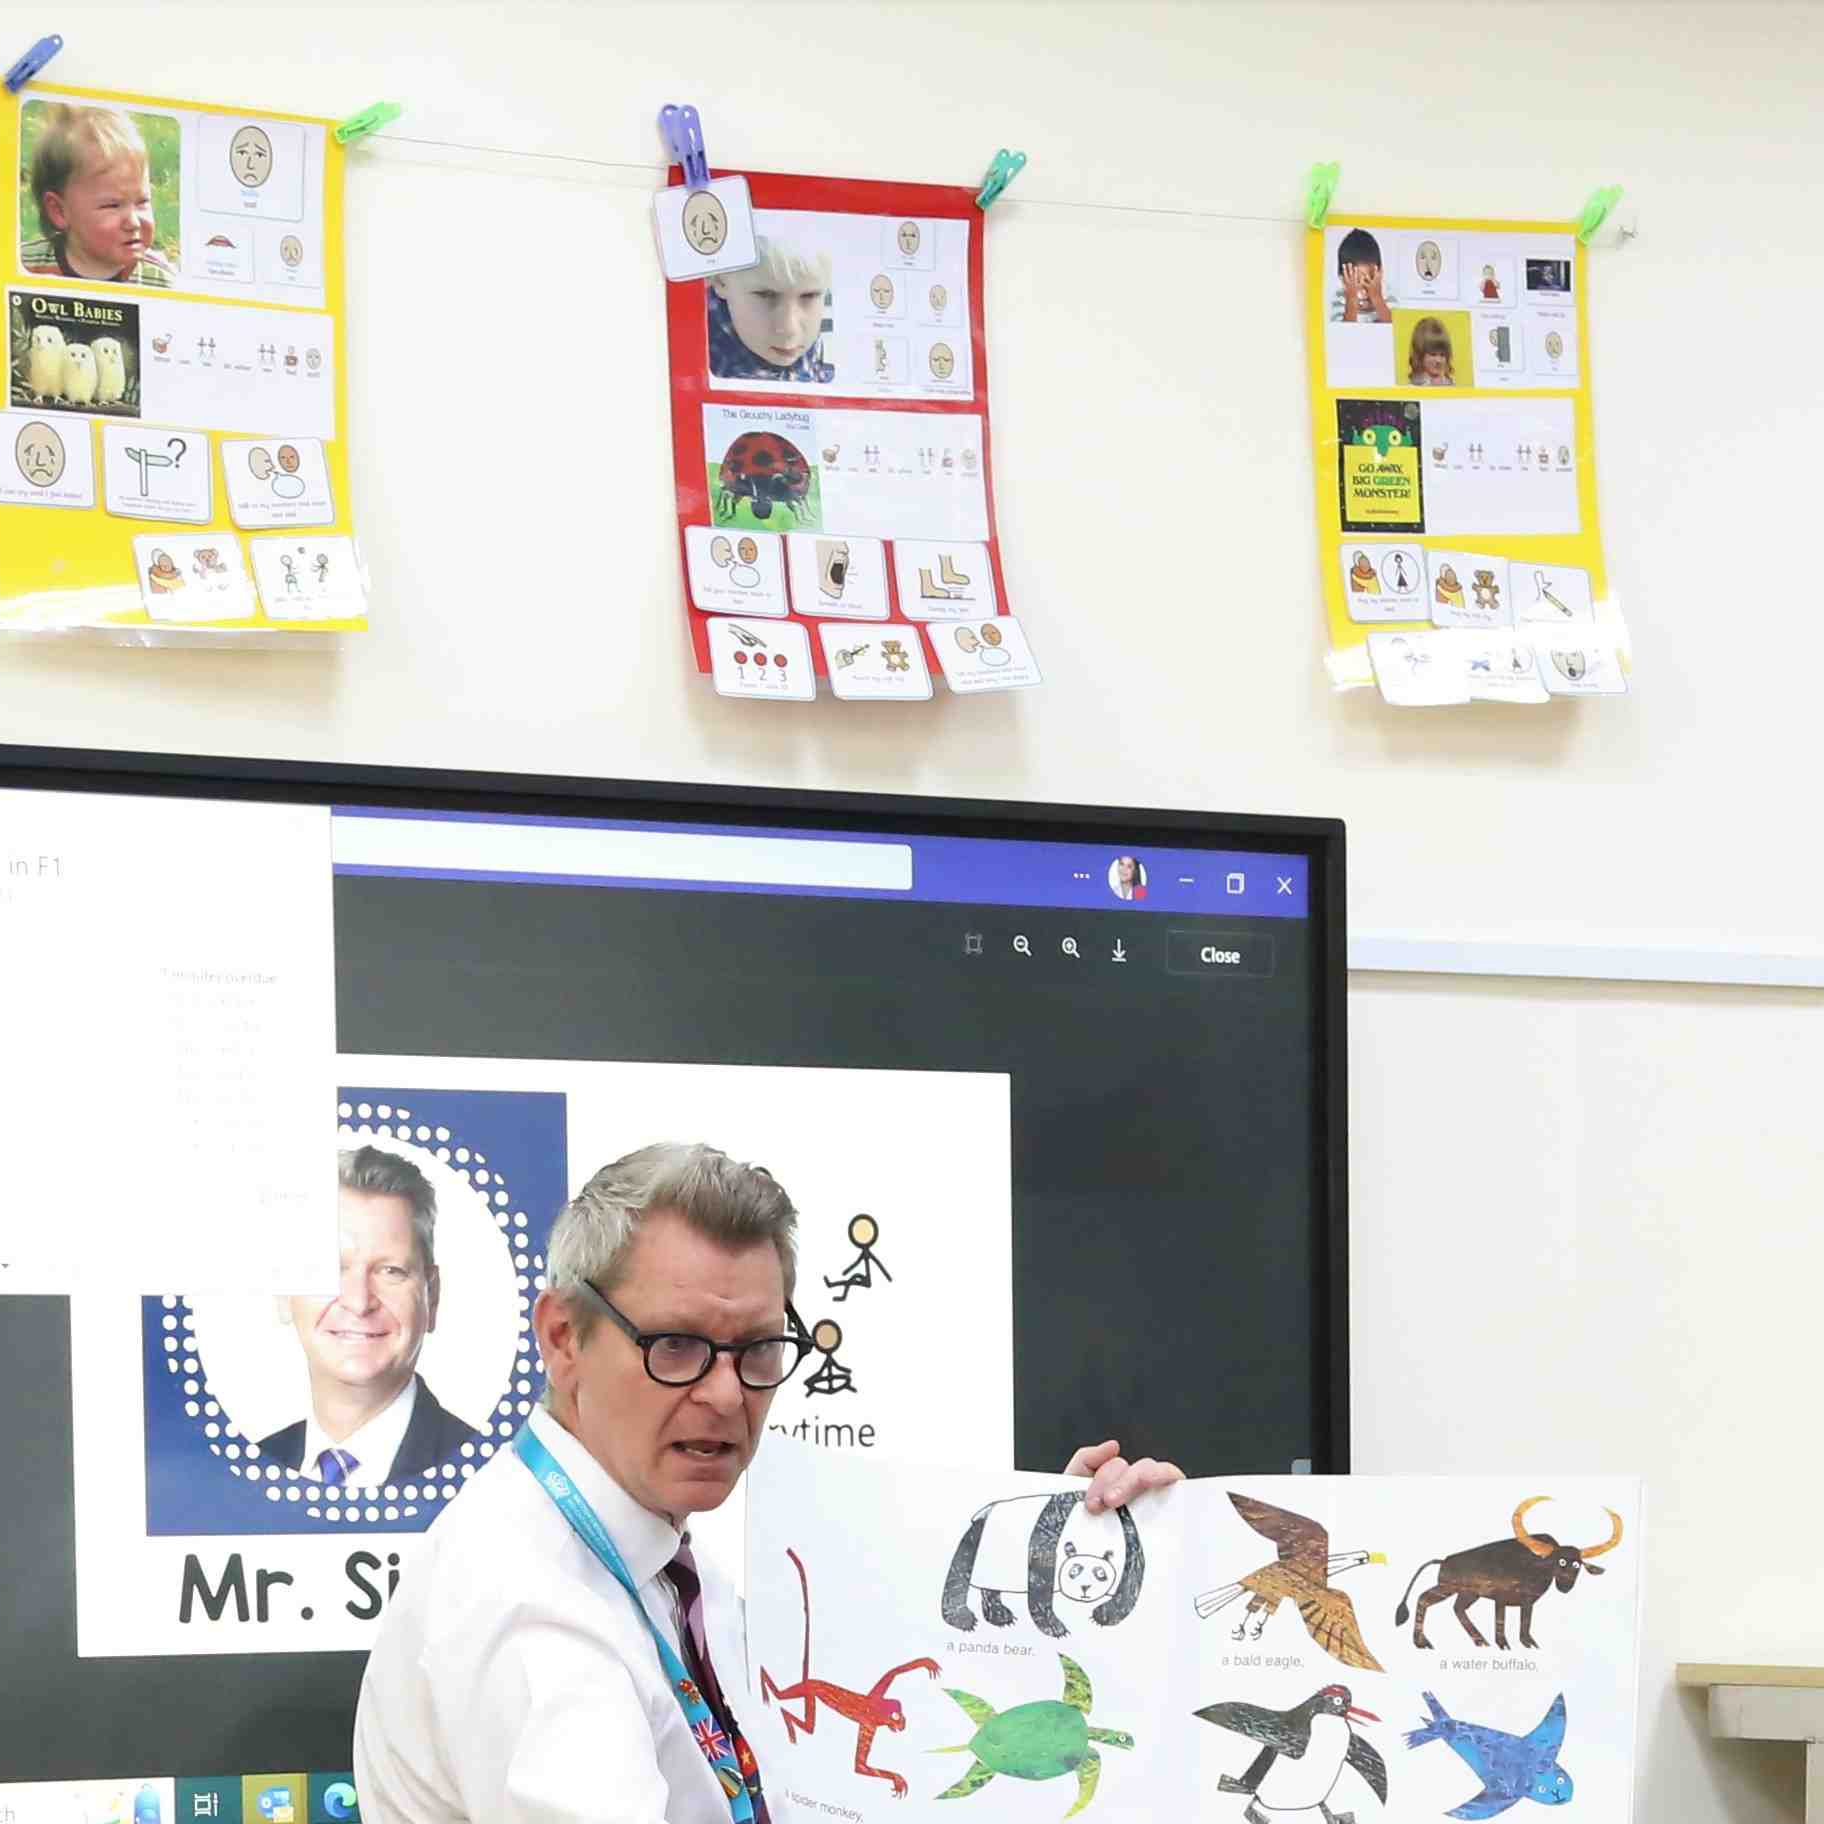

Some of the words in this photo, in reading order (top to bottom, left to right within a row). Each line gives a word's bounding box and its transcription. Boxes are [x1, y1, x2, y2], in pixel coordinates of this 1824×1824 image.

[72, 301, 124, 323] BABIES
[9, 857, 29, 877] in
[39, 855, 63, 877] F1
[1200, 946, 1241, 965] Close
[179, 1552, 315, 1624] Mr.
[959, 1641, 1000, 1656] panda
[1234, 1654, 1261, 1666] bald
[1452, 1658, 1488, 1671] water
